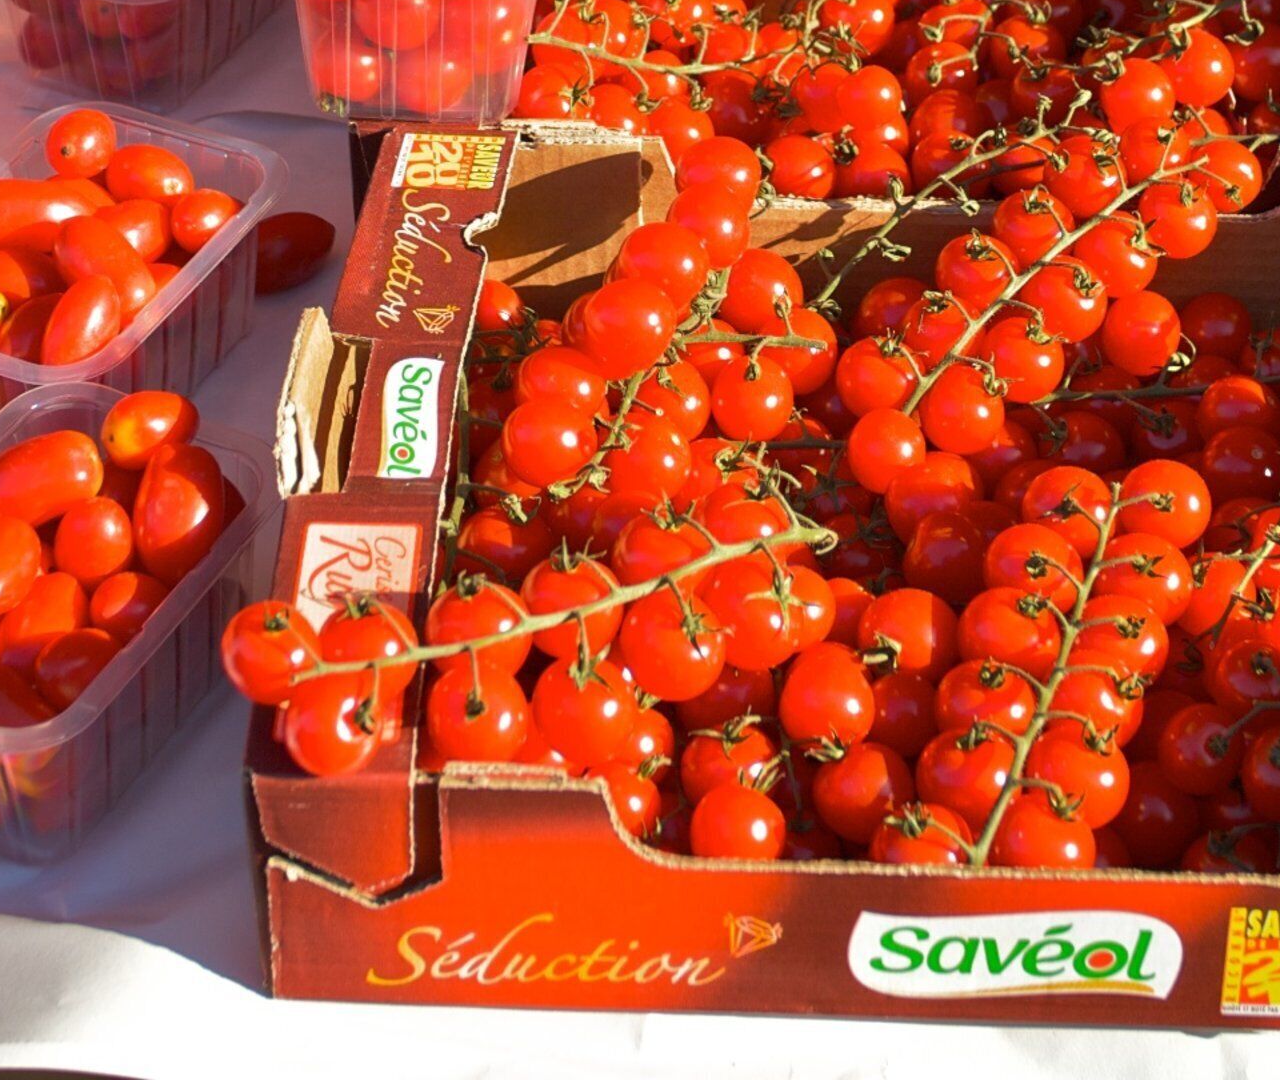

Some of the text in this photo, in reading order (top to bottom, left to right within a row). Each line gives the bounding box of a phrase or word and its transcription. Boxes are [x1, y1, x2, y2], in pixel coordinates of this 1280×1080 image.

[466, 143, 503, 190] SAVEUR
[375, 188, 453, 329] Séduction
[387, 363, 433, 478] Savéol
[367, 913, 727, 988] Séduction
[869, 922, 1156, 982] Savéol
